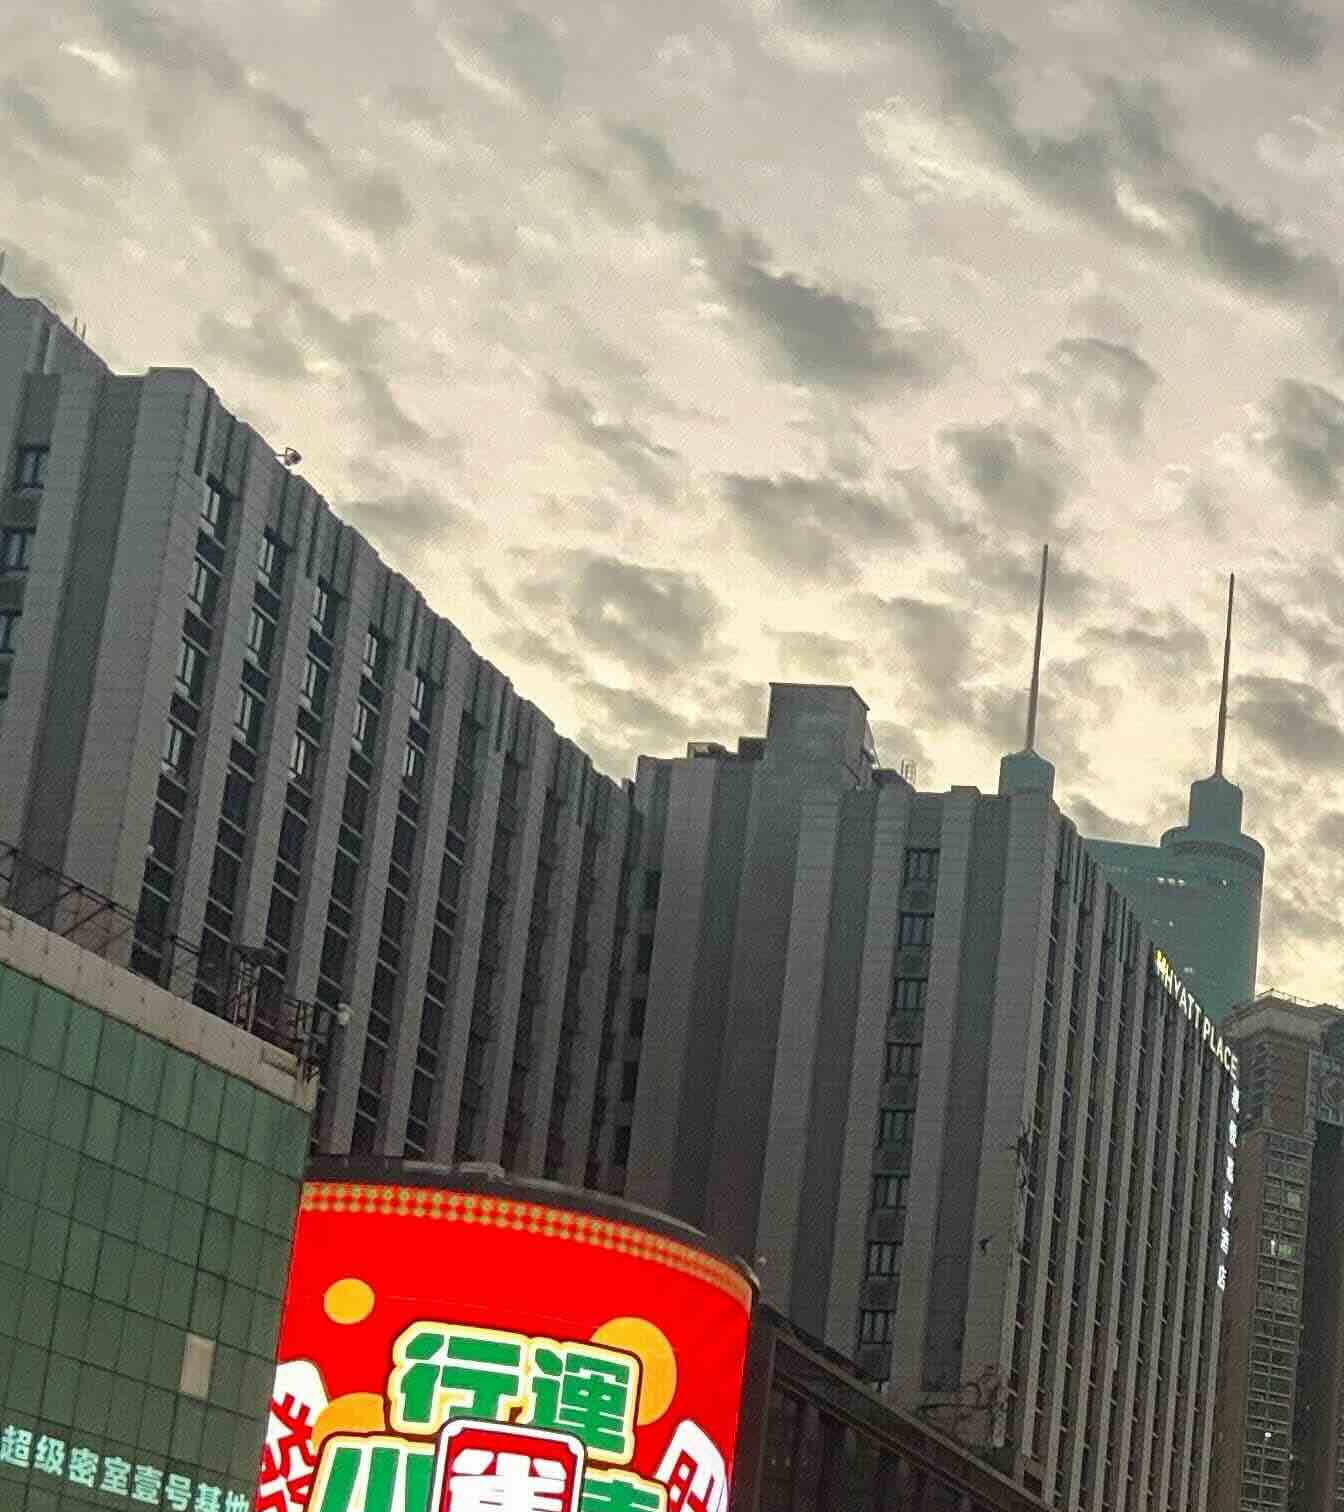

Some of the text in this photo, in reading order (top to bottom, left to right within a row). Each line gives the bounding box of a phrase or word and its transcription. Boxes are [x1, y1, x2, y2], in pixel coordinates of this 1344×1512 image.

[1164, 969, 1239, 1081] HYATT PLACE
[396, 1326, 636, 1462] 行運
